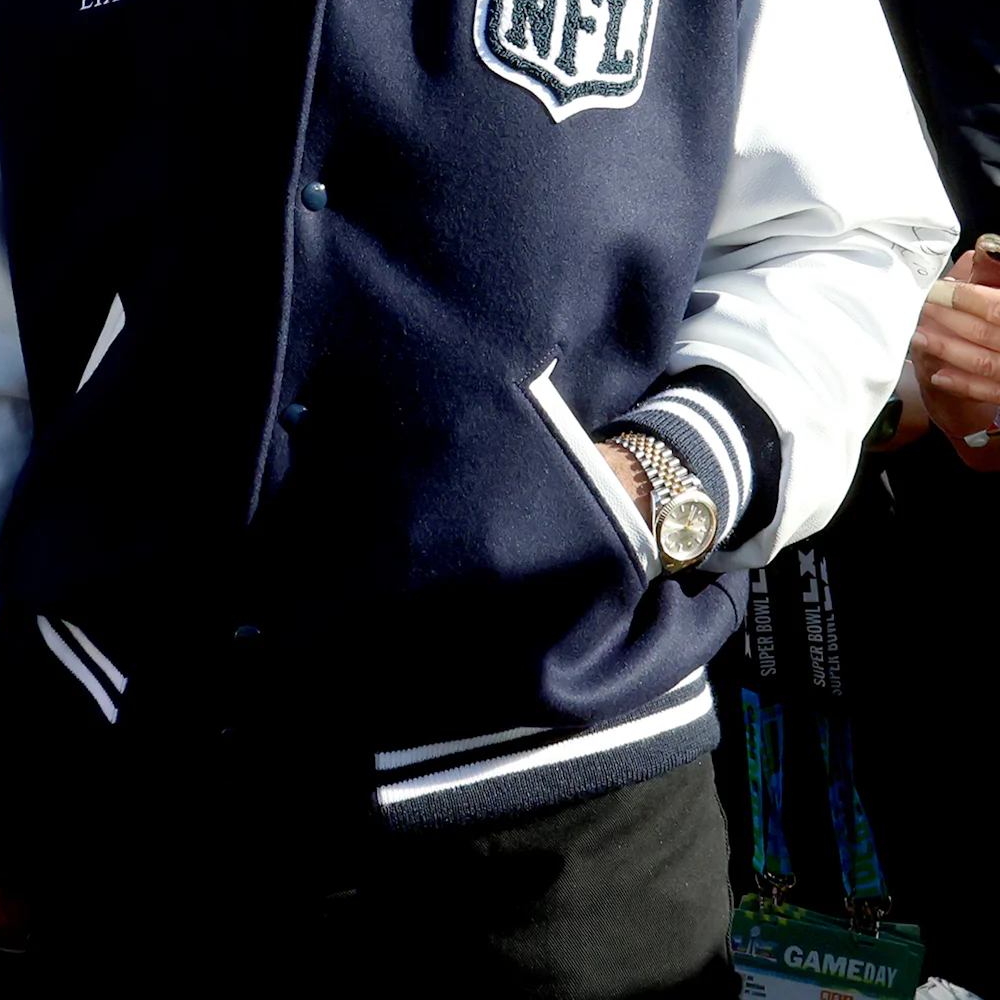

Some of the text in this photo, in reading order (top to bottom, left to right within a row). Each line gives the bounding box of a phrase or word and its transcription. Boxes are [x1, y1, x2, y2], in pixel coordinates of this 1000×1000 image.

[753, 596, 773, 633] BOWL
[798, 548, 826, 688] SUPER BOWL LX
[757, 635, 777, 677] SUPER
[783, 944, 899, 990] GAMEDAY
